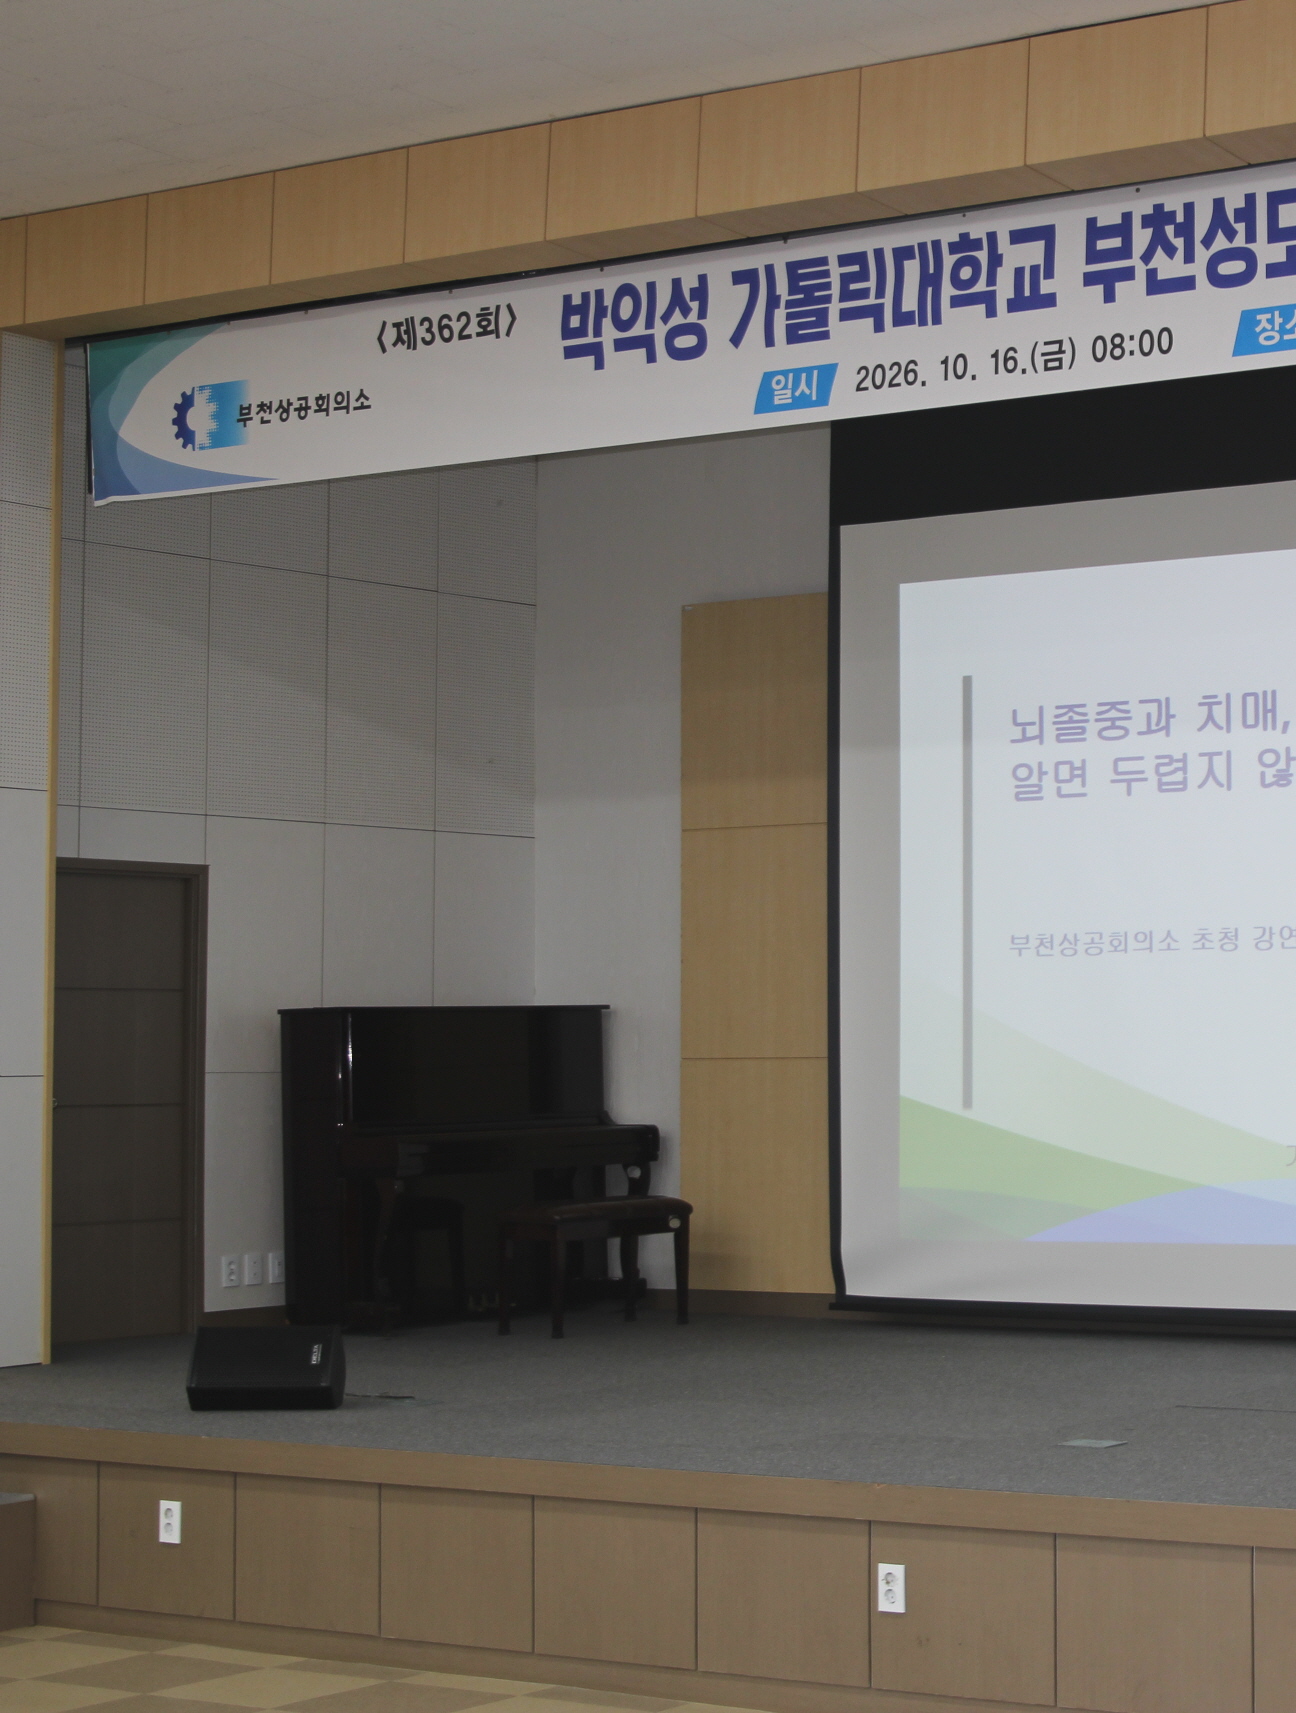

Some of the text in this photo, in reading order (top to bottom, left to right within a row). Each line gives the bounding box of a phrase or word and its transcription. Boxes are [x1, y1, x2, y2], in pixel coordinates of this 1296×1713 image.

[561, 273, 710, 370] 박익성
[729, 224, 1057, 350] 가톨릭대학교
[771, 370, 818, 403] 일시
[856, 360, 926, 392] 2026.
[941, 353, 977, 382] 10.
[1091, 327, 1174, 361] 08:00
[236, 388, 372, 428] 부천상공회의소
[1010, 690, 1291, 746] 뇌졸중과 치매,
[1010, 757, 1090, 802] 알면
[1109, 749, 1234, 797] 두렵지
[1009, 928, 1180, 957] 부천상공회의소
[1191, 927, 1241, 953] 초청
